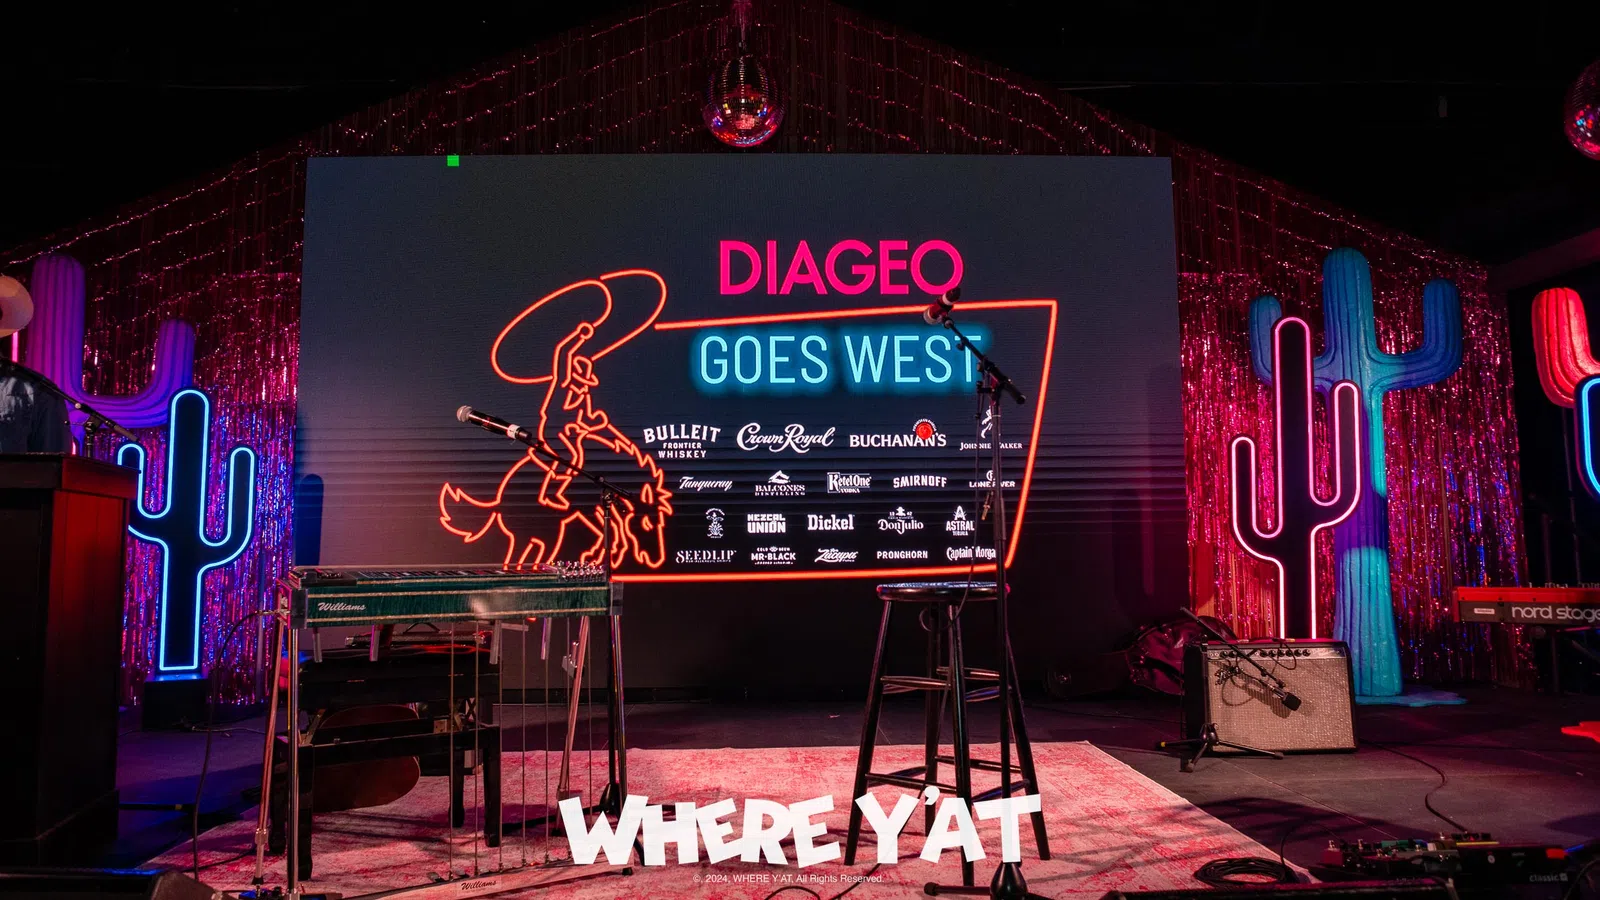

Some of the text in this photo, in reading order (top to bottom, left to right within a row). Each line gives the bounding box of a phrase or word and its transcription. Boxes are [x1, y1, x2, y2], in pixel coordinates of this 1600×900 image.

[719, 239, 964, 295] DIAGEO
[700, 335, 982, 384] GOES WEST
[643, 423, 722, 444] BULLEIT
[736, 422, 836, 454] Crown Royal
[850, 433, 947, 448] BUCHANAN'S
[657, 450, 707, 459] WHISKEY
[679, 476, 733, 492] Tanqueray
[828, 474, 871, 492] Ketel One
[893, 475, 947, 489] SMIRNOFF
[807, 513, 855, 531] Dickel
[945, 520, 975, 531] ASTRAL
[675, 550, 735, 563] SEEDLIP
[876, 551, 928, 560] PRONGHORN
[946, 546, 997, 561] Captain Morga
[317, 602, 366, 612] Williams
[1511, 605, 1552, 619] nord
[460, 880, 497, 891] Williams
